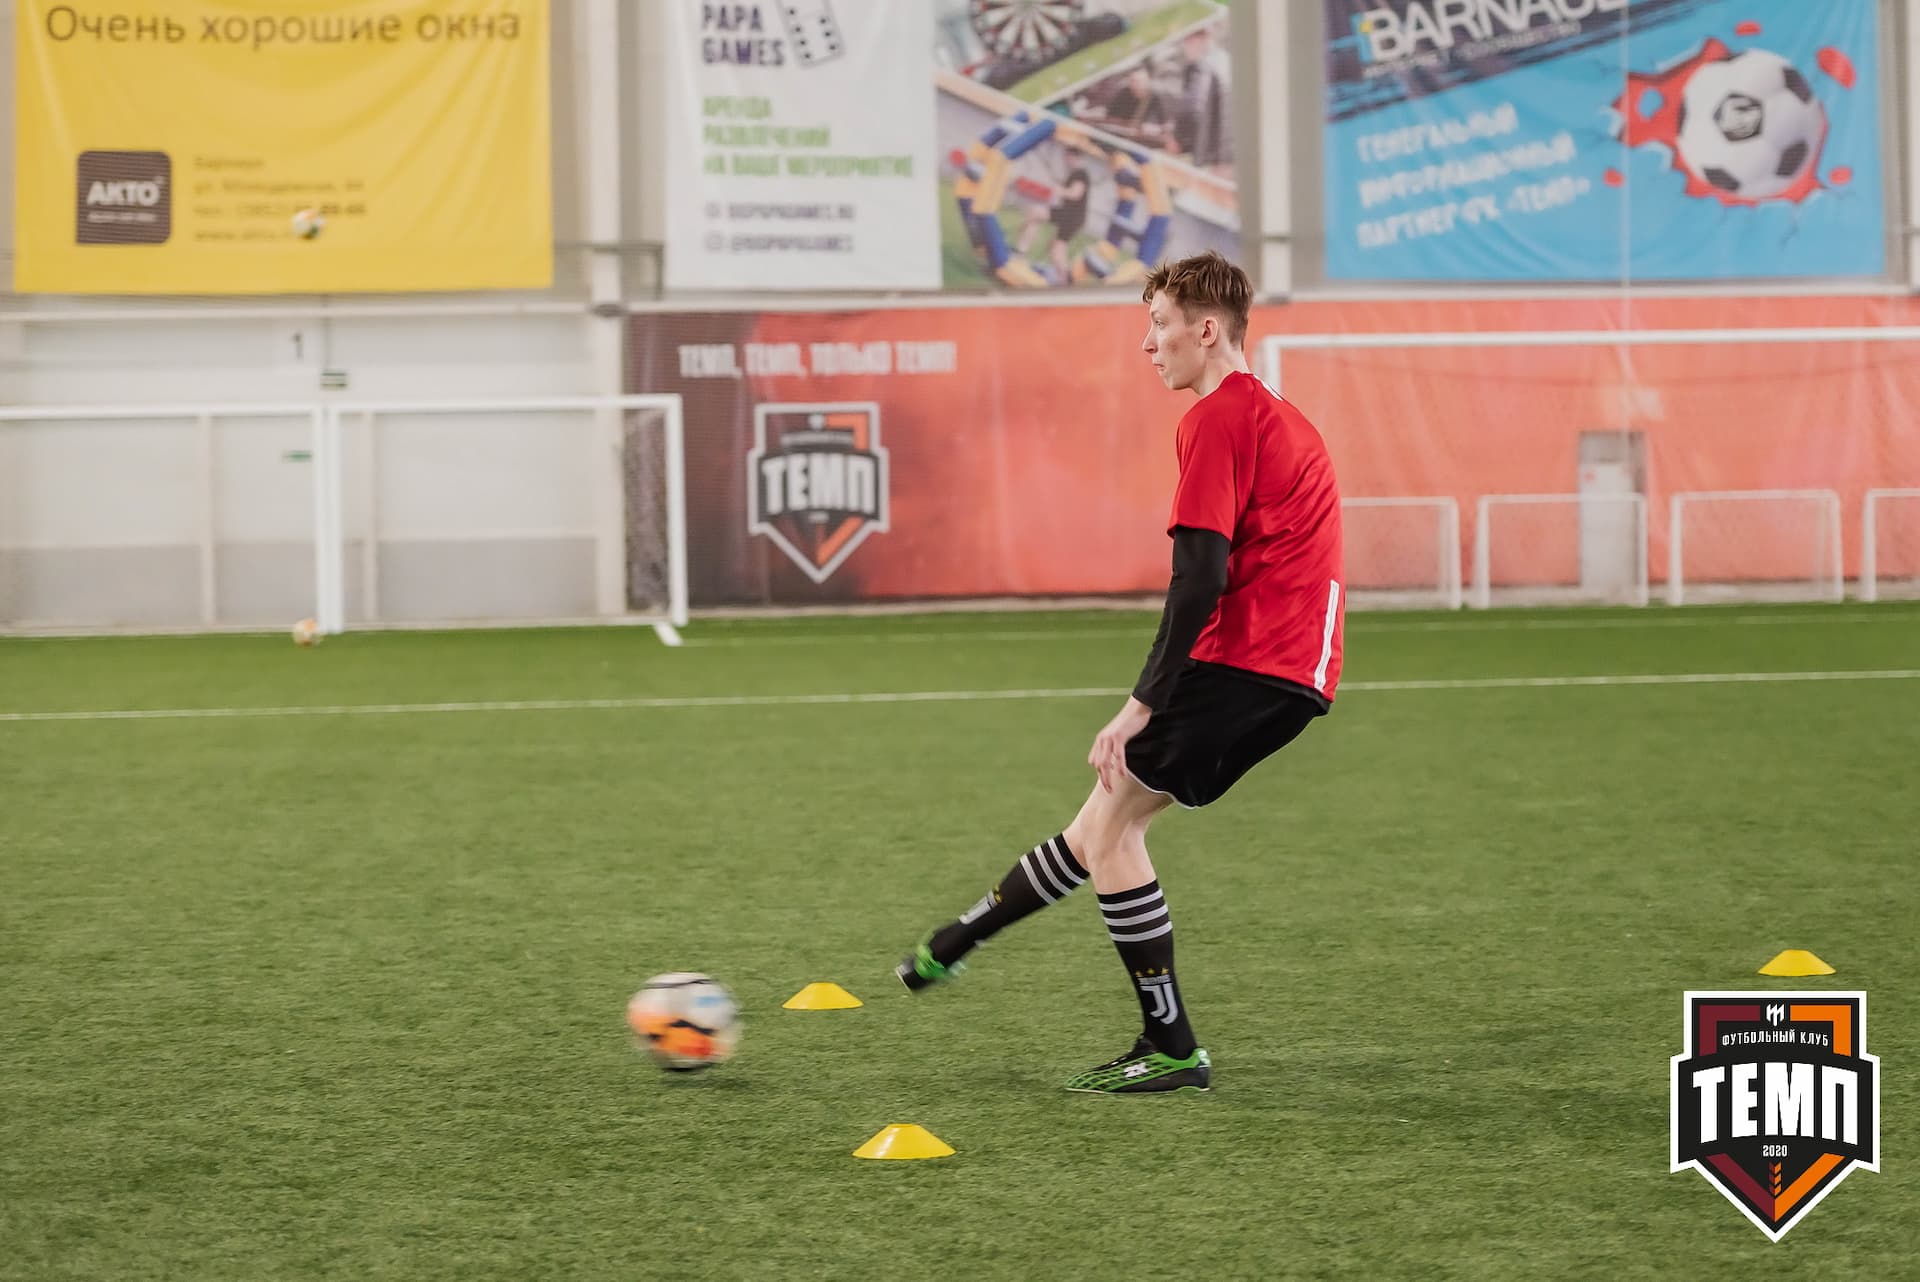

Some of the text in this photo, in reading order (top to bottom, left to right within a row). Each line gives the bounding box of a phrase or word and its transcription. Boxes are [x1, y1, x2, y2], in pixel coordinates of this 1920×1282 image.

[46, 5, 520, 51] Очень хорошие окна
[703, 5, 762, 30] PAPA
[703, 38, 784, 65] GAMES
[761, 452, 876, 515] ТЕМП
